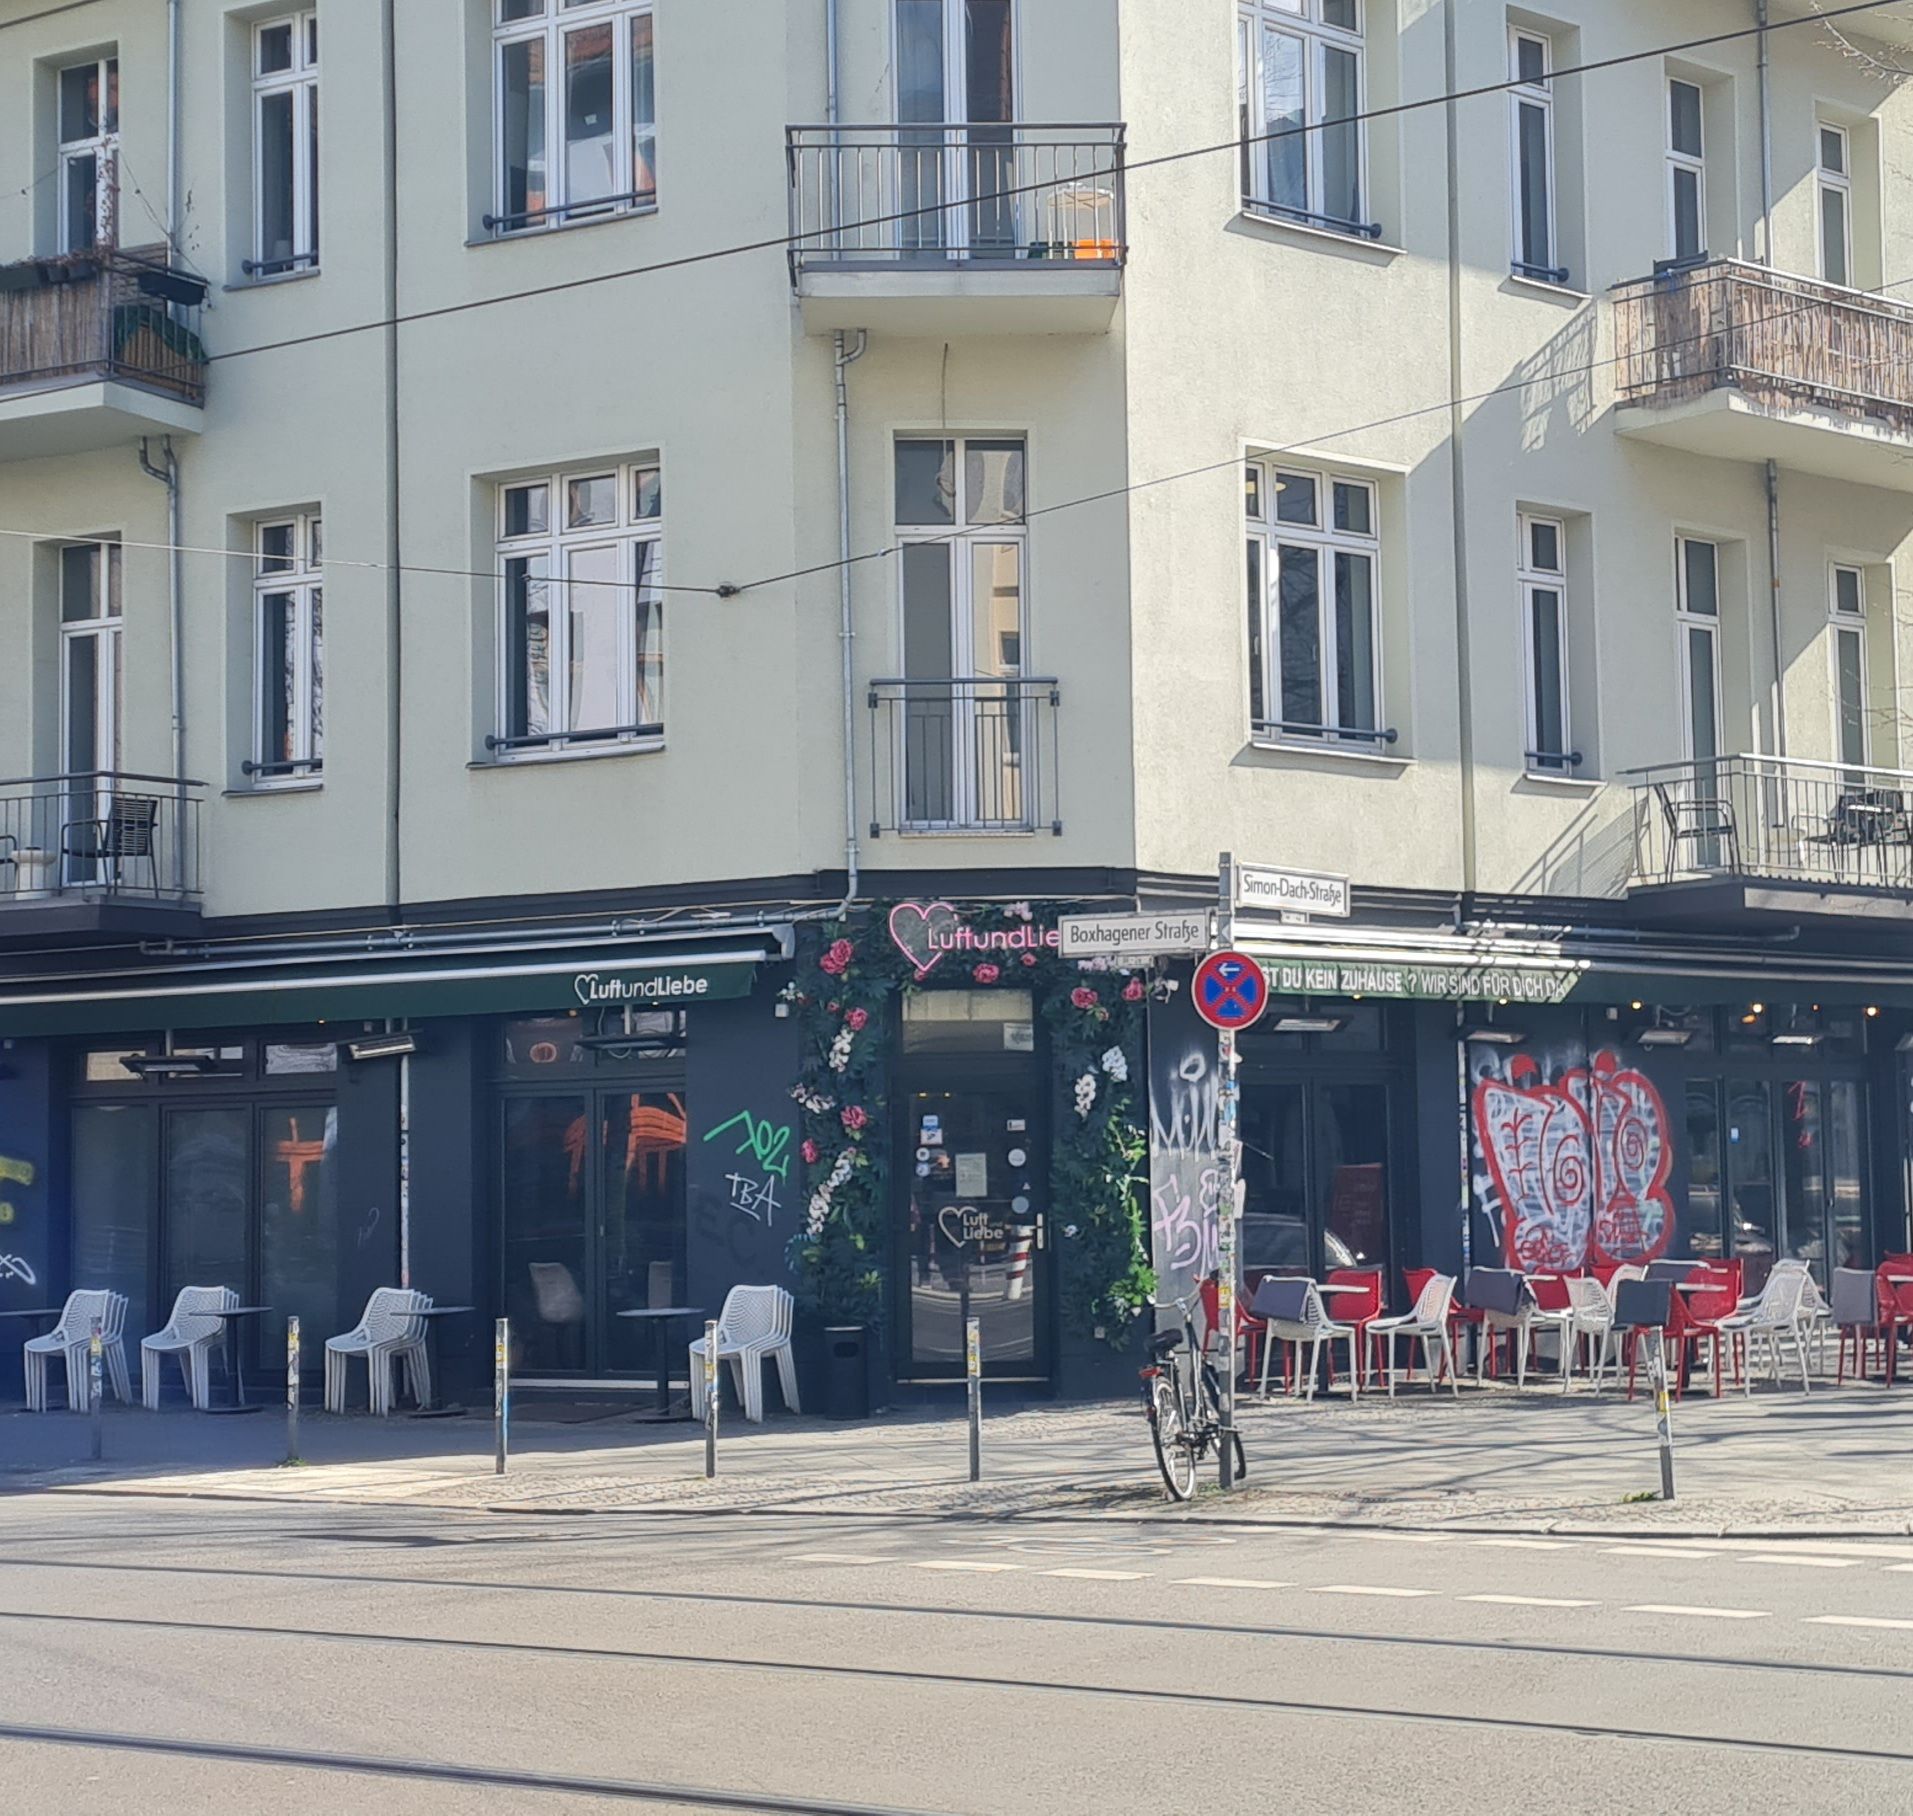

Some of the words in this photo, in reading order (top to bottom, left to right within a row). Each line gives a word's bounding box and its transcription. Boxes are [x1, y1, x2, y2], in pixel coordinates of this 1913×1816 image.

[1243, 873, 1342, 907] Simon-Dach-Straße
[928, 924, 1060, 950] LuftundLie
[1070, 923, 1150, 946] Boxhagener
[1154, 920, 1199, 943] Straße
[590, 975, 708, 999] LuftundLiebe
[1262, 966, 1279, 987] ST
[1282, 966, 1302, 989] DU
[1305, 967, 1338, 990] KEIN
[1340, 969, 1402, 993] ZUHAUSE
[1421, 973, 1447, 994] WIR
[1449, 974, 1480, 996] SIND
[1482, 972, 1510, 996] FÜR
[1513, 976, 1543, 998] DICH
[963, 1212, 988, 1226] Luft
[963, 1226, 1004, 1239] Liebe
